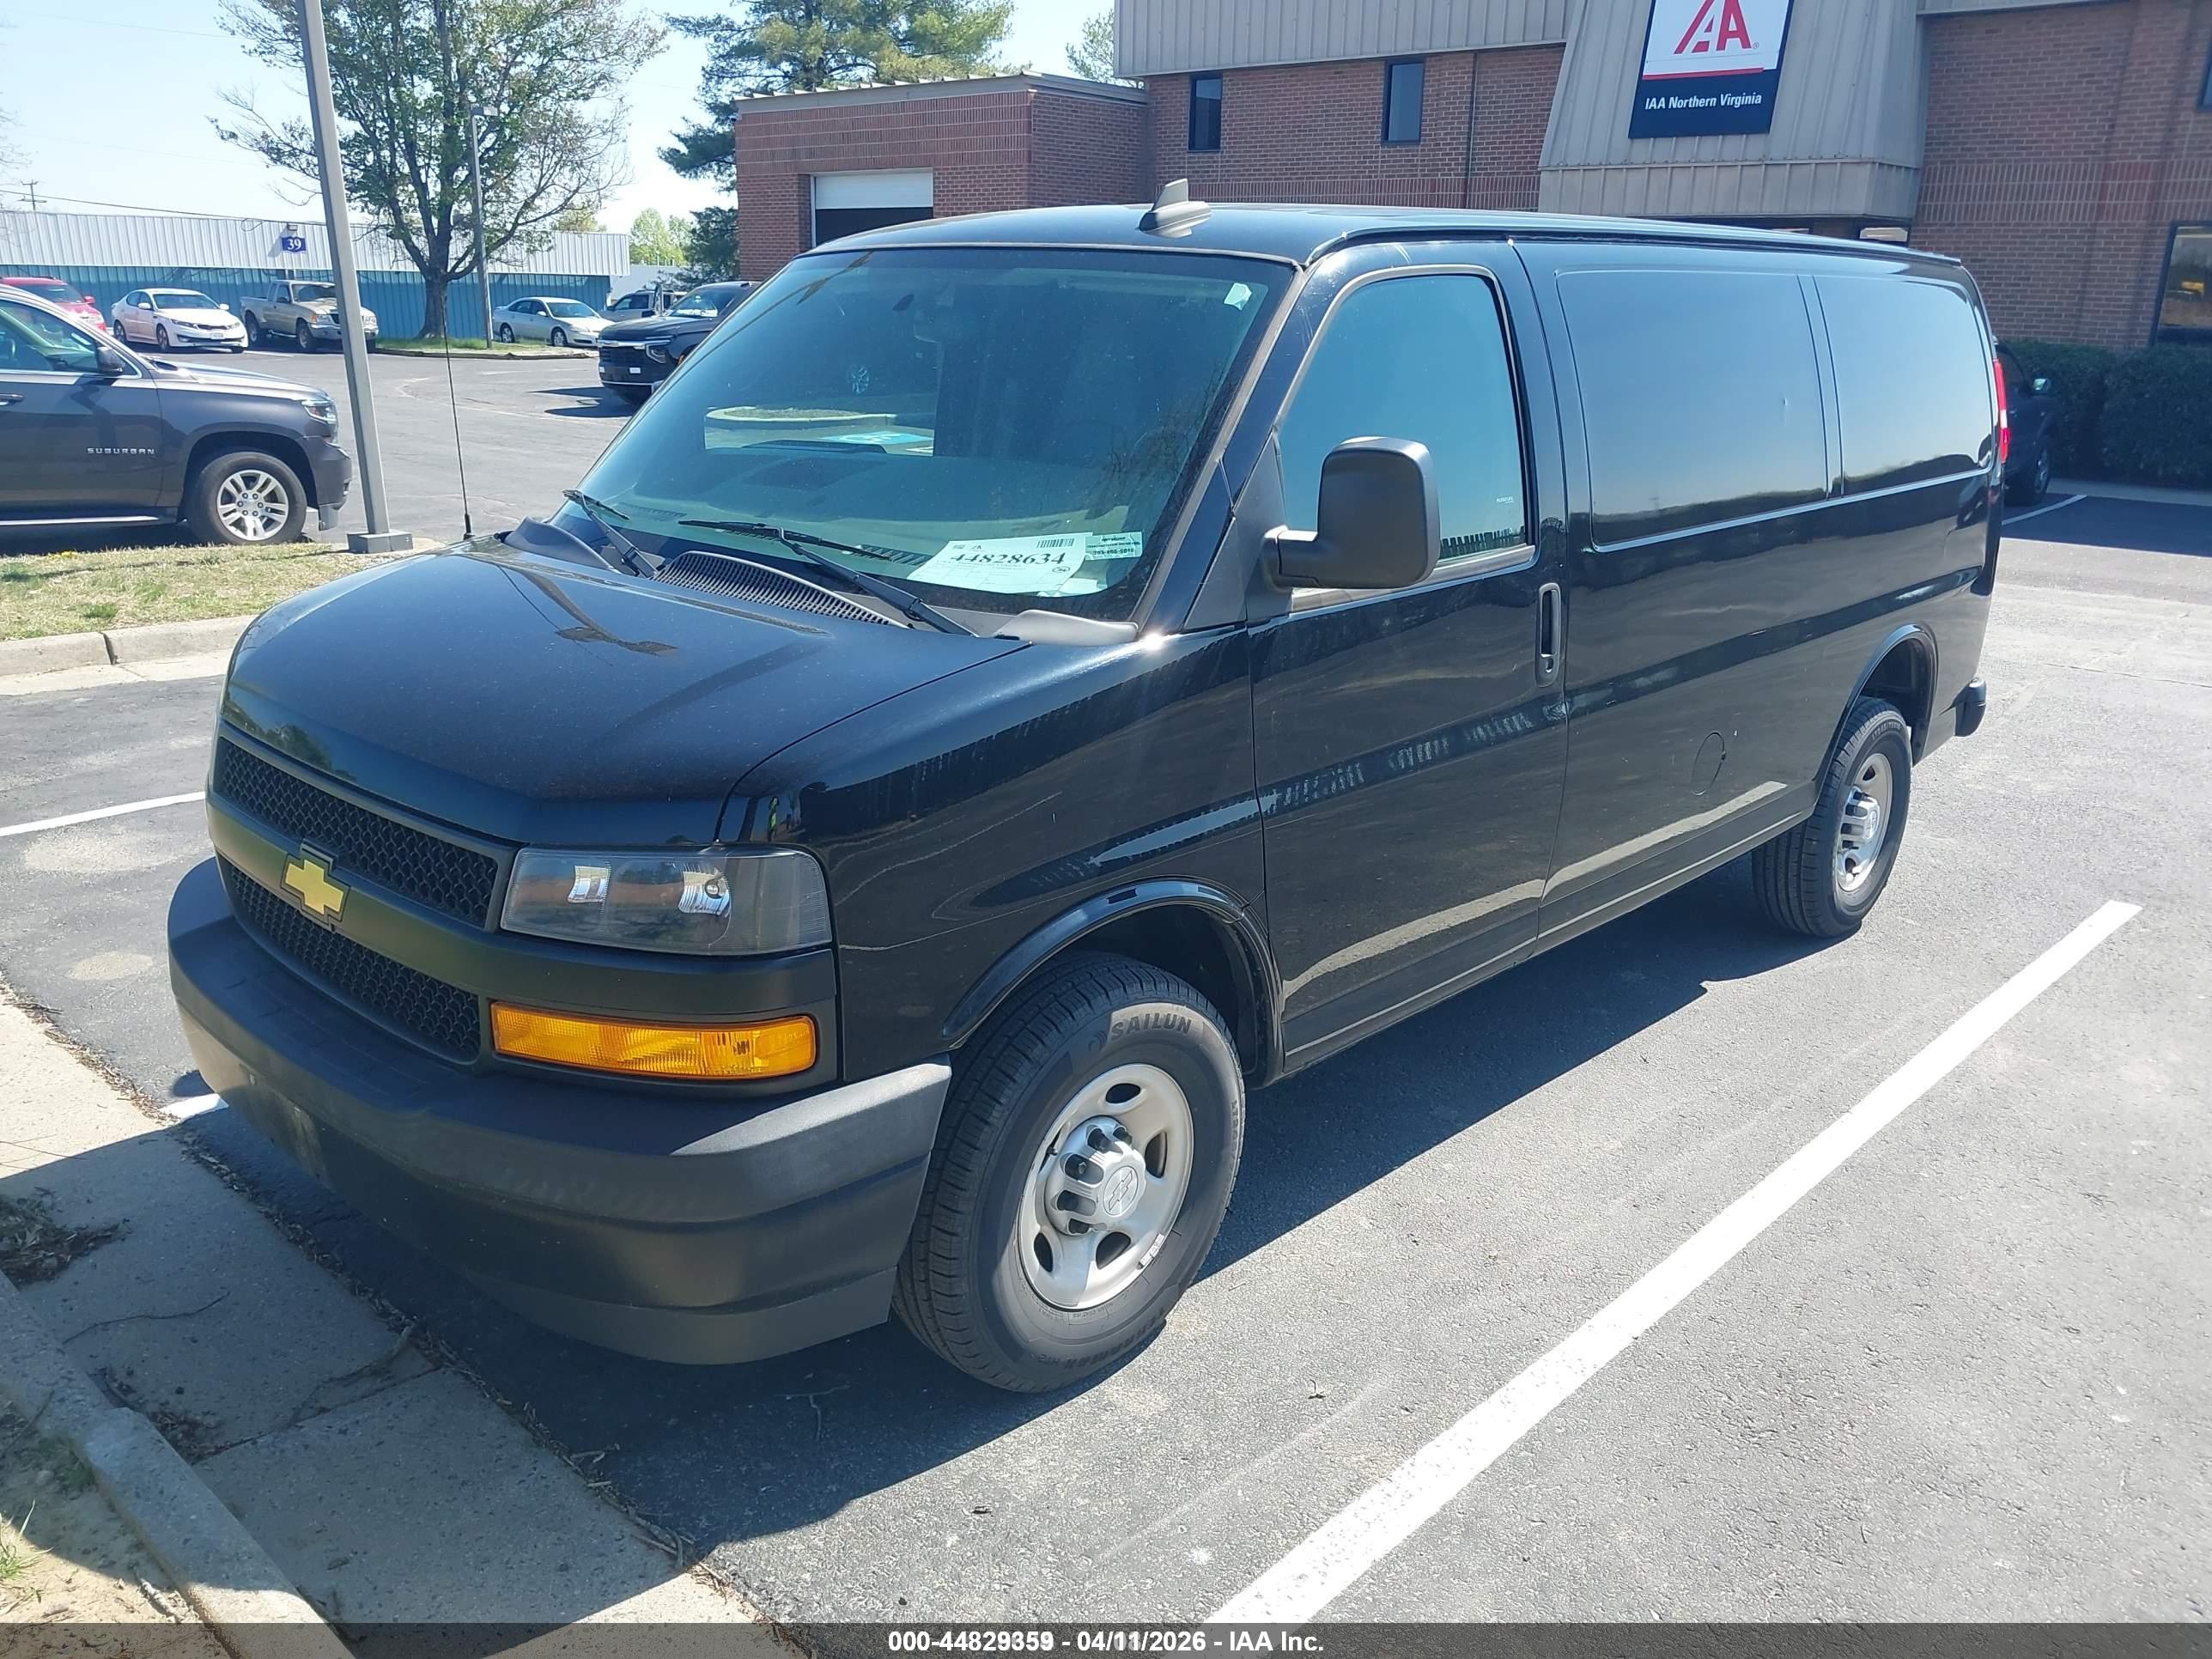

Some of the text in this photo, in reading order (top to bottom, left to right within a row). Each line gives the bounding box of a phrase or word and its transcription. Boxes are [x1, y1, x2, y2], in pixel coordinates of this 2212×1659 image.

[1645, 92, 1762, 110] IAA Northern Virginia
[287, 239, 302, 250] 39
[951, 552, 1066, 565] 44828634
[1111, 1012, 1192, 1041] SAILUN
